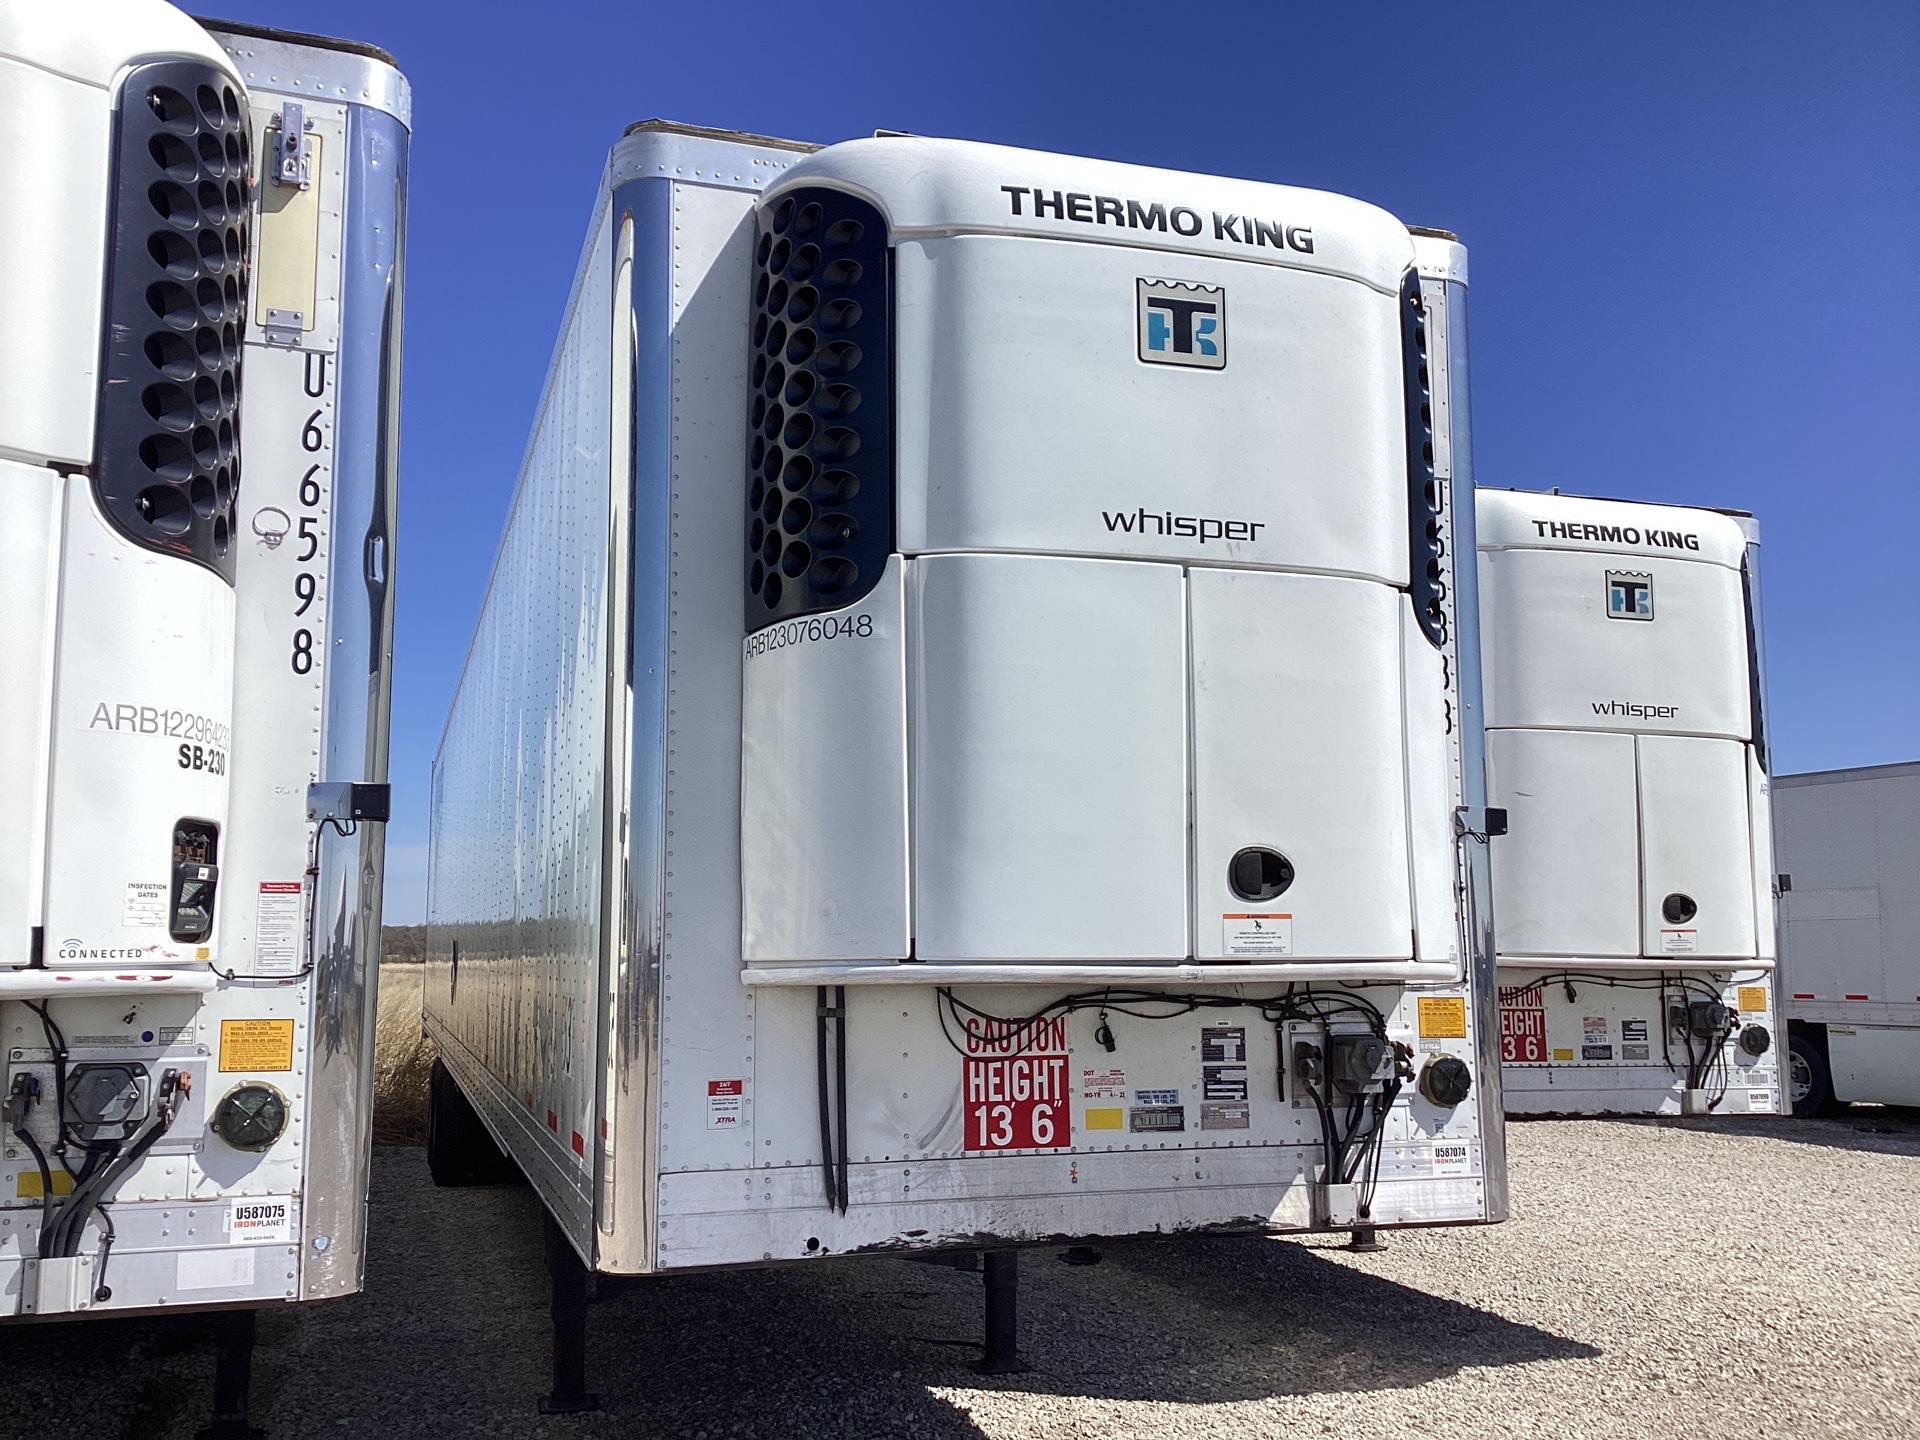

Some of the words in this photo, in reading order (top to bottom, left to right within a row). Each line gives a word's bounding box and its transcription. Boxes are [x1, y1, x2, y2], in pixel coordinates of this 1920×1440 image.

[1001, 185, 1203, 237] THERMO
[1212, 211, 1314, 255] KING
[1101, 508, 1265, 544] whisper
[1531, 519, 1641, 545] THERMO
[1645, 528, 1700, 551] KING
[745, 614, 873, 660] ARB123076048
[1591, 700, 1679, 720] whisper
[177, 743, 226, 776] SB-230
[59, 949, 142, 958] CONNECTED
[1498, 986, 1543, 1007] AUTION
[966, 1016, 1065, 1053] CAUTION
[1500, 1010, 1542, 1036] EIGHT
[969, 1059, 1064, 1102] HEIGHT
[715, 1116, 737, 1124] XTRA
[974, 1101, 1016, 1147] 13'
[1031, 1100, 1062, 1145] 6"
[1435, 1147, 1466, 1157] U587074
[234, 1218, 286, 1228] IRONPLANET
[236, 1204, 285, 1219] U587075
